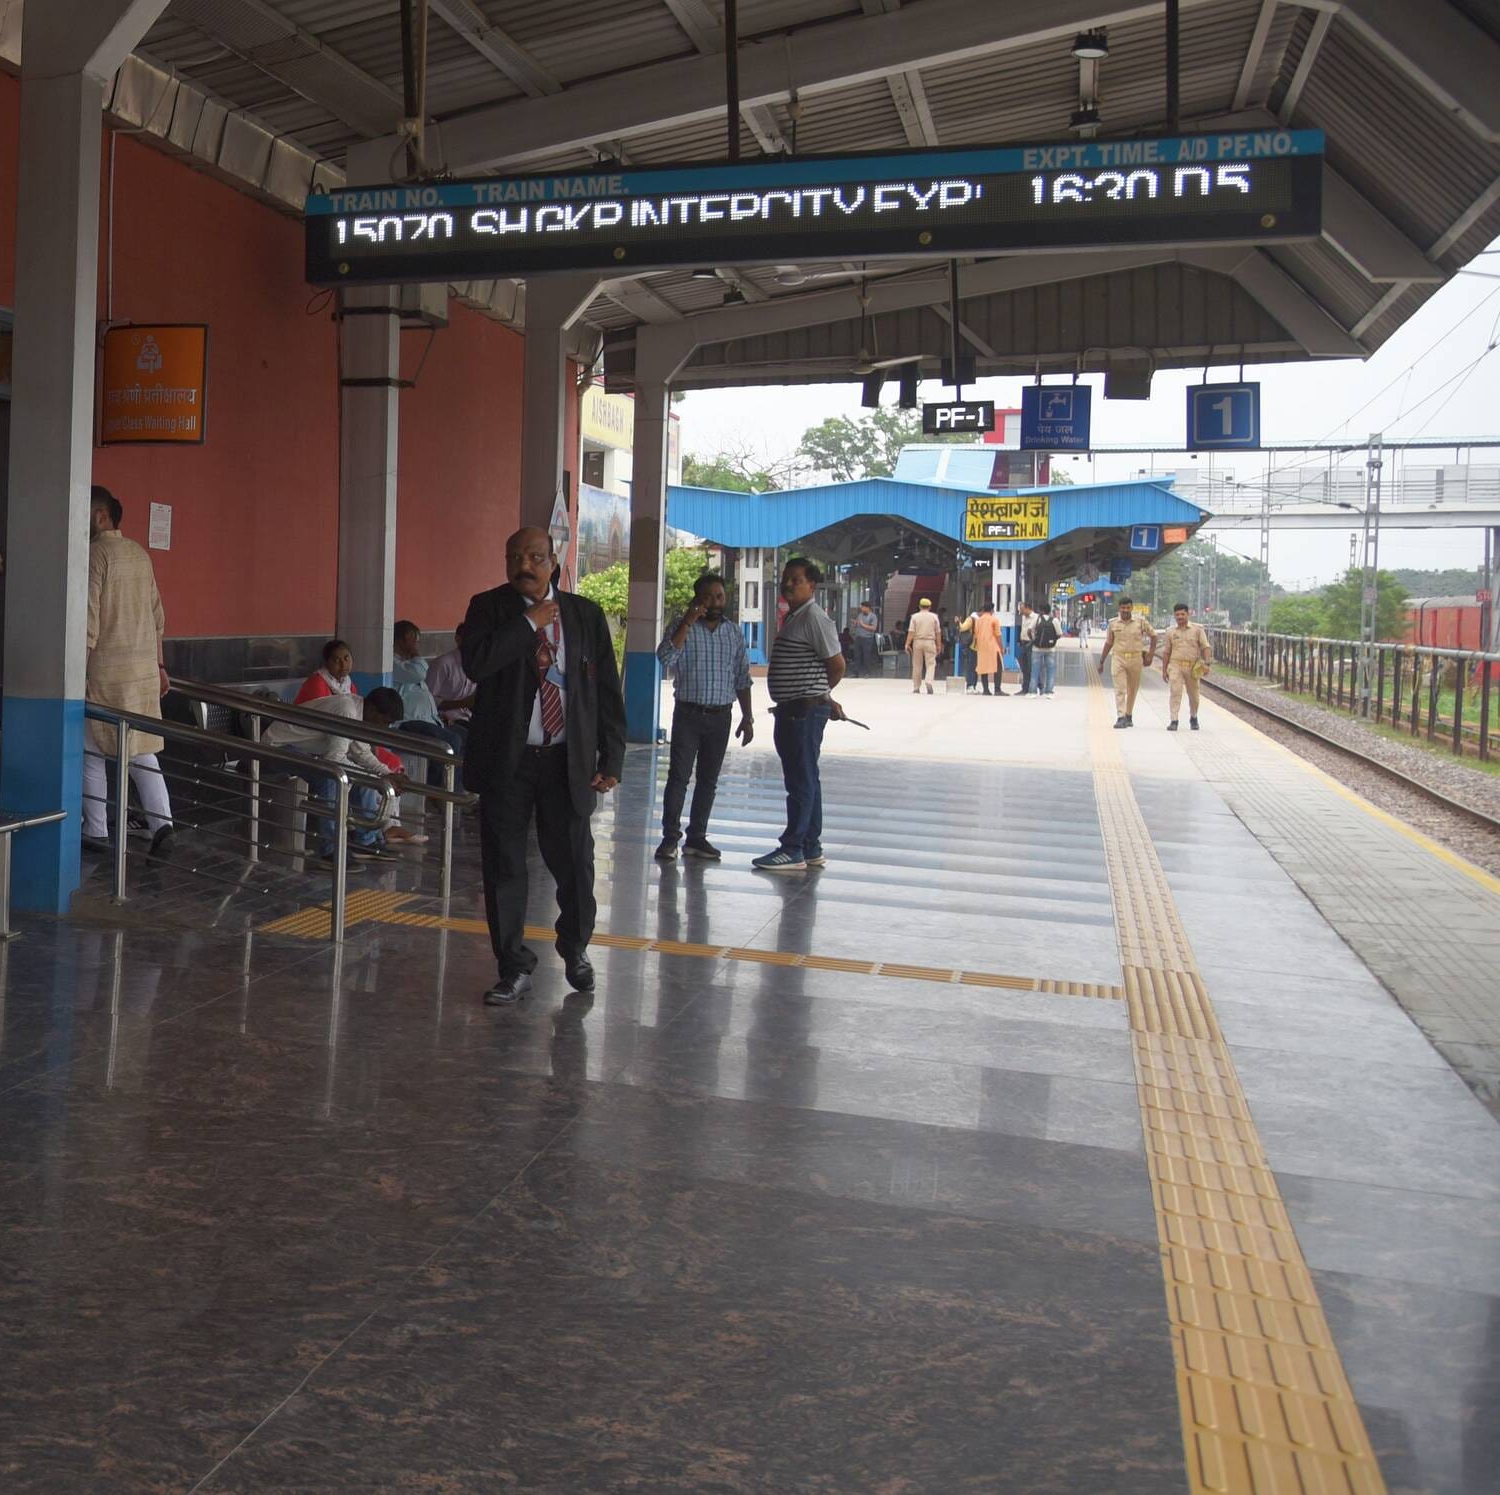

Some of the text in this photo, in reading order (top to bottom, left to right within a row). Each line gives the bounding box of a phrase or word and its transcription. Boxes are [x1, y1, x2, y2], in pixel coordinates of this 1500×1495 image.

[330, 189, 398, 213] TRAIN
[405, 187, 444, 208] NO.
[472, 180, 545, 203] TRAIN
[553, 175, 629, 199] NAME.
[1023, 145, 1090, 170] EXPT.
[1099, 141, 1166, 165] TIME.
[1177, 139, 1208, 162] A/D
[178, 415, 197, 431] Hall
[591, 395, 625, 433] AISHBAGH
[934, 406, 986, 430] PF-1
[1211, 397, 1233, 436] 1
[1025, 435, 1084, 445] Drinking Water
[969, 498, 1028, 521] ऐशबाग
[988, 525, 1011, 536] PF-1
[1029, 522, 1047, 538] JN.
[1138, 527, 1148, 546] 1
